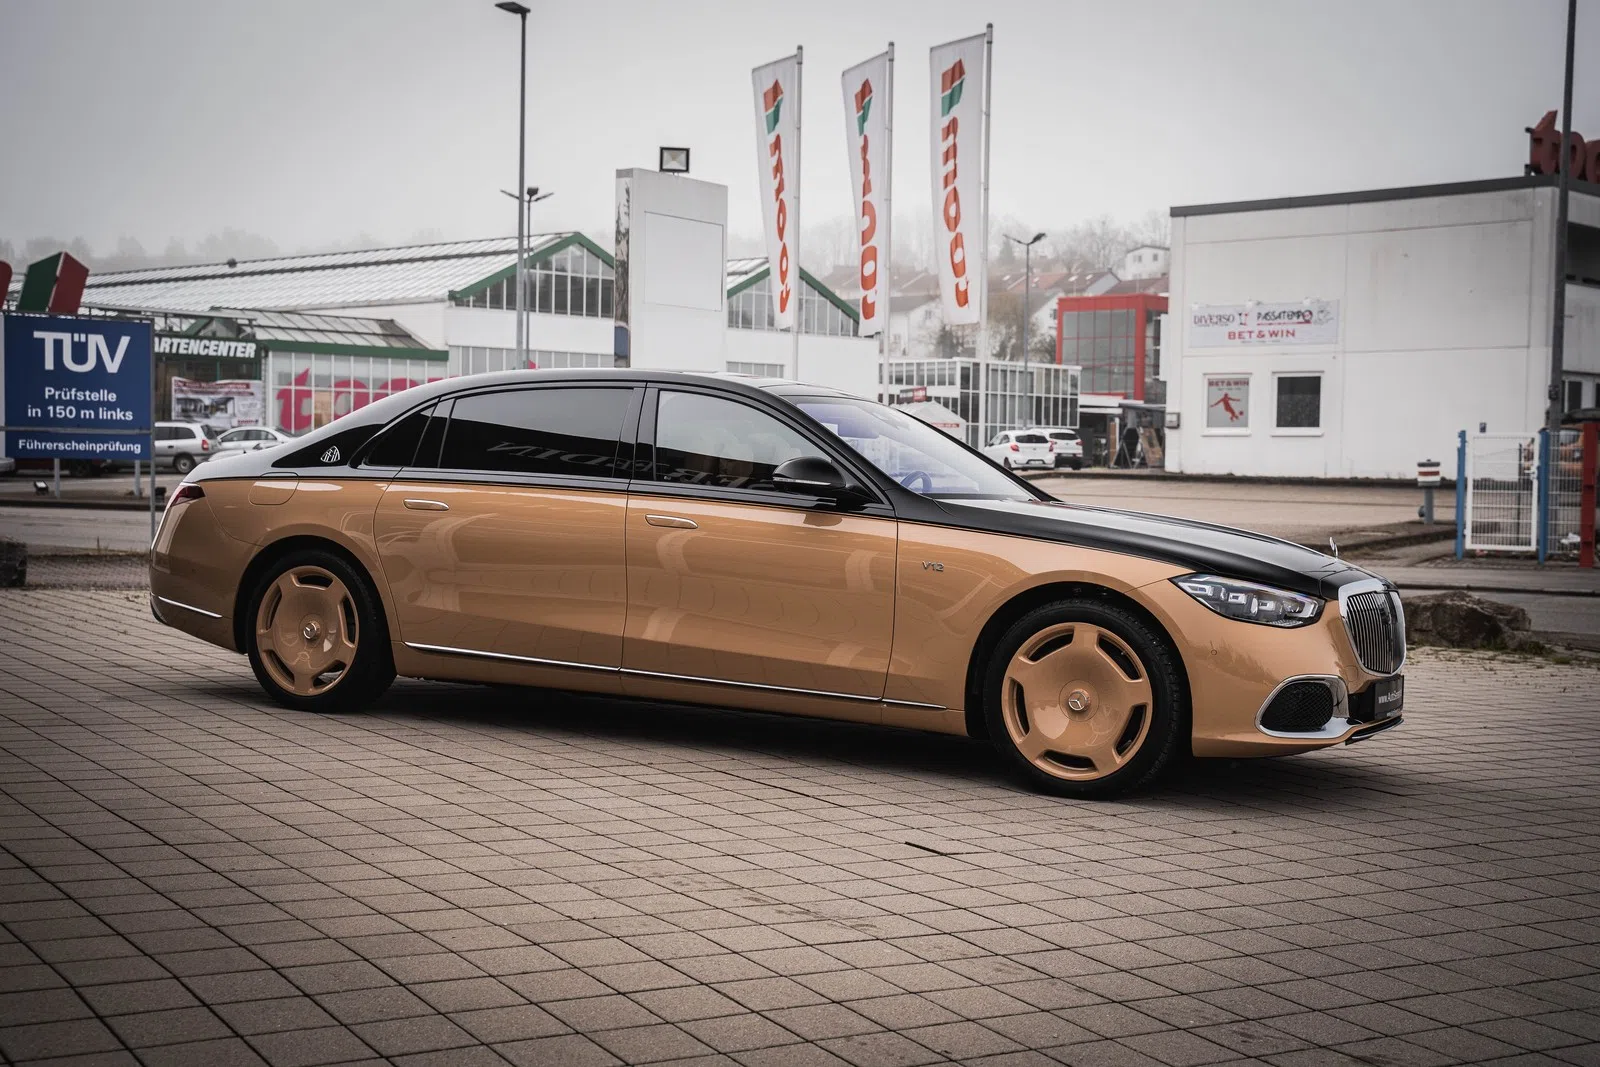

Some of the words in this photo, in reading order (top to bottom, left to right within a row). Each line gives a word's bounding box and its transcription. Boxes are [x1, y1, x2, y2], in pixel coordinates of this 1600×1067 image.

[33, 330, 131, 374] TÜV
[45, 387, 117, 402] Prüfstelle
[27, 405, 41, 418] in
[47, 405, 76, 419] 150
[80, 409, 95, 419] m
[99, 407, 133, 421] links
[18, 439, 141, 454] Führerscheinprüfung
[922, 560, 944, 572] V12
